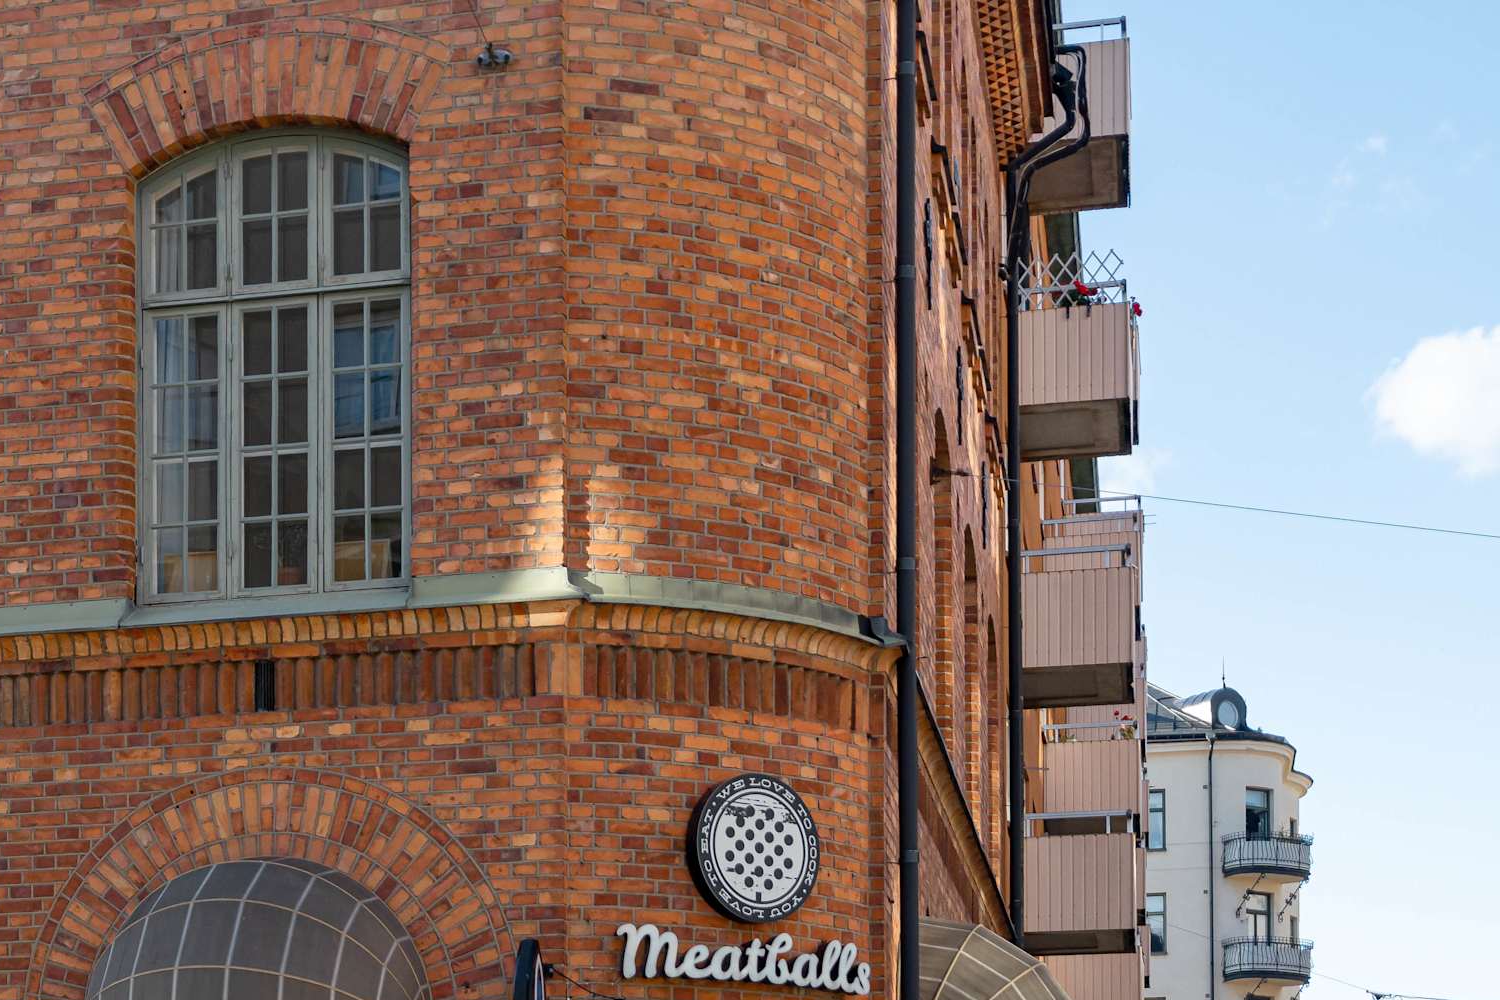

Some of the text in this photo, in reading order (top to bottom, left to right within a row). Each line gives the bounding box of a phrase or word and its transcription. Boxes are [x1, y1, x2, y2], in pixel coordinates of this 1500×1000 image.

[701, 777, 818, 919] WE LOVE TO COOK YOU LOVE TO EAT
[616, 923, 871, 996] Meatballs
